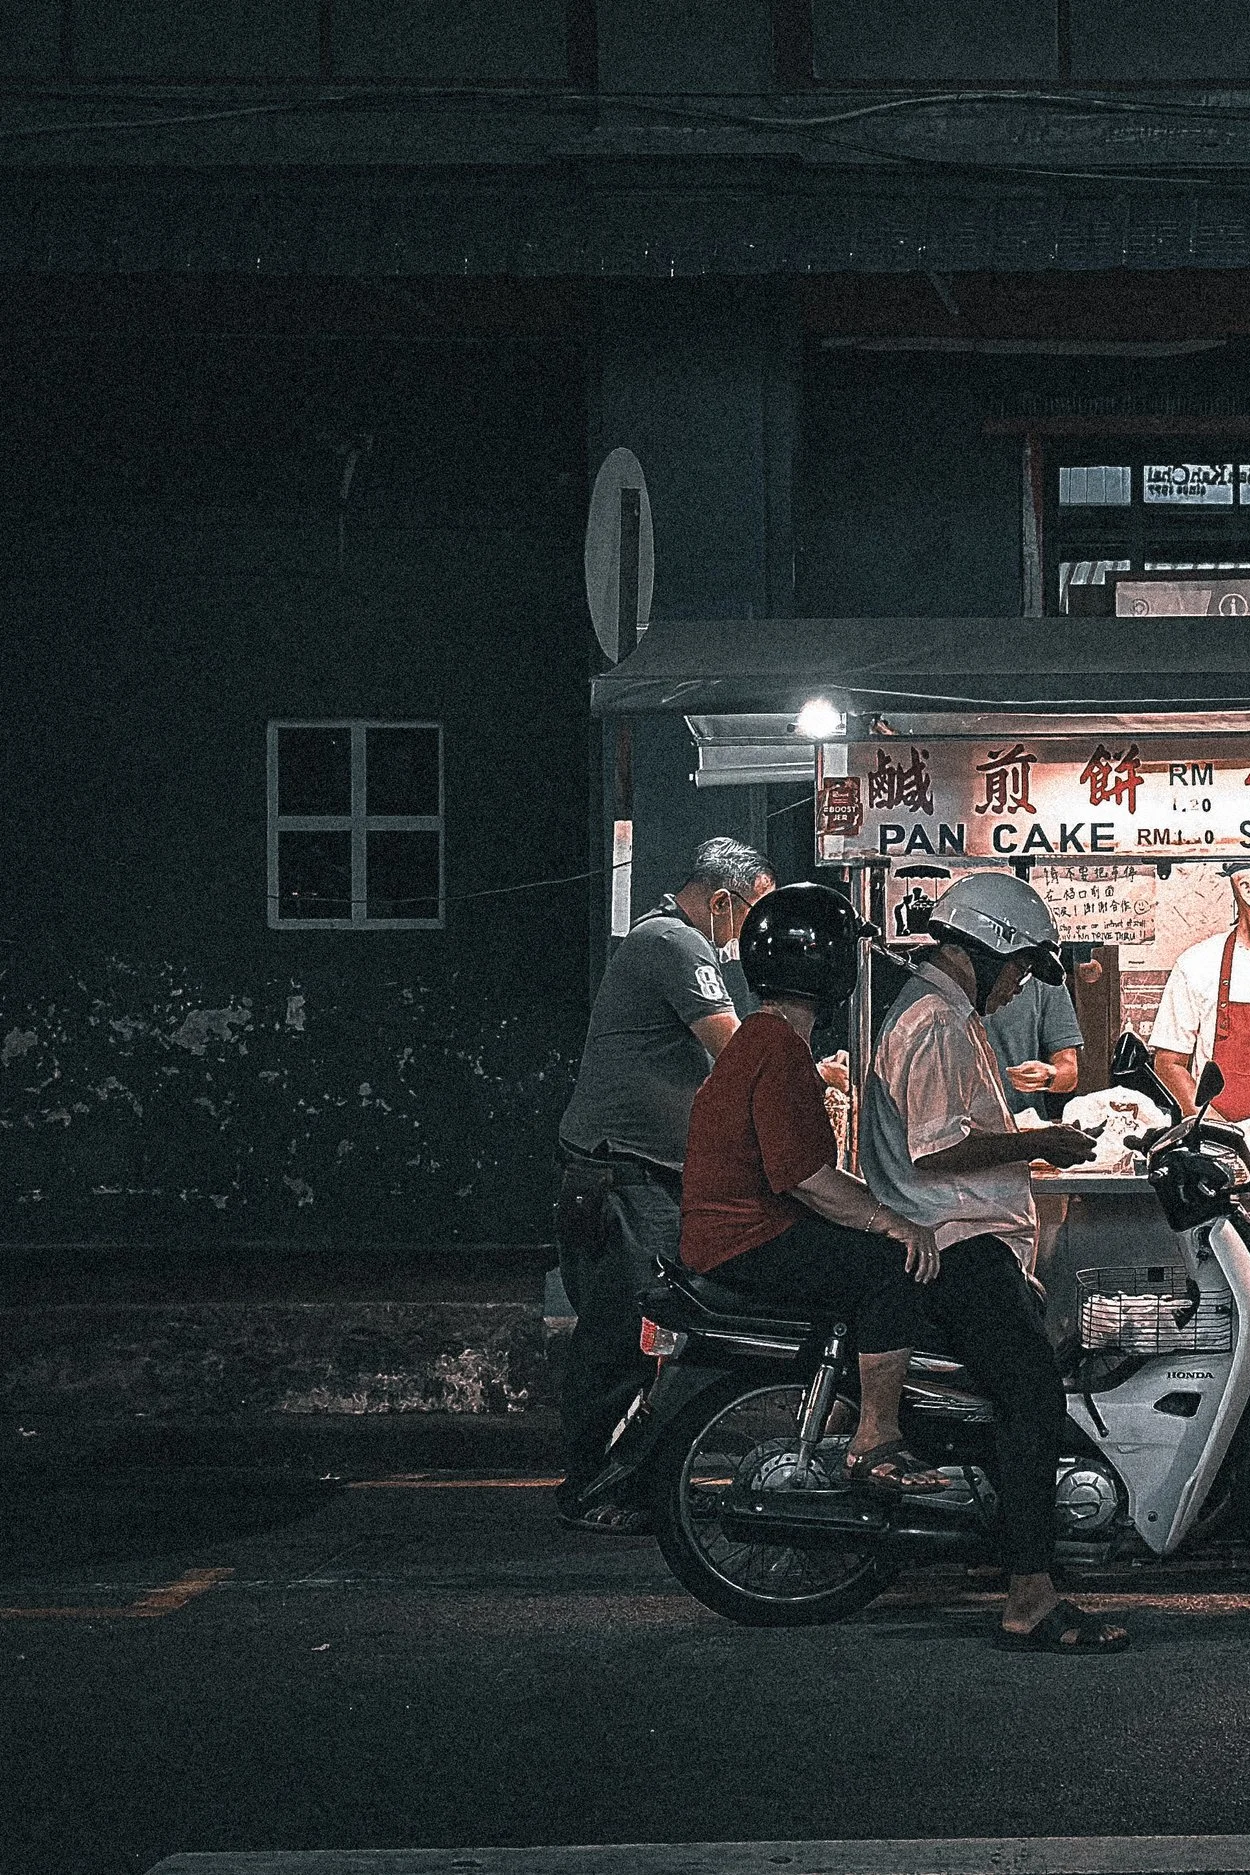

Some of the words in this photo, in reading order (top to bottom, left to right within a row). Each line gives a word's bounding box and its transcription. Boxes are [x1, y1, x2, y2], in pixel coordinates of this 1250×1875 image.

[1169, 763, 1213, 786] RM
[879, 823, 965, 855] PAN
[992, 822, 1115, 854] CAKE
[1167, 1371, 1214, 1380] HONDA
